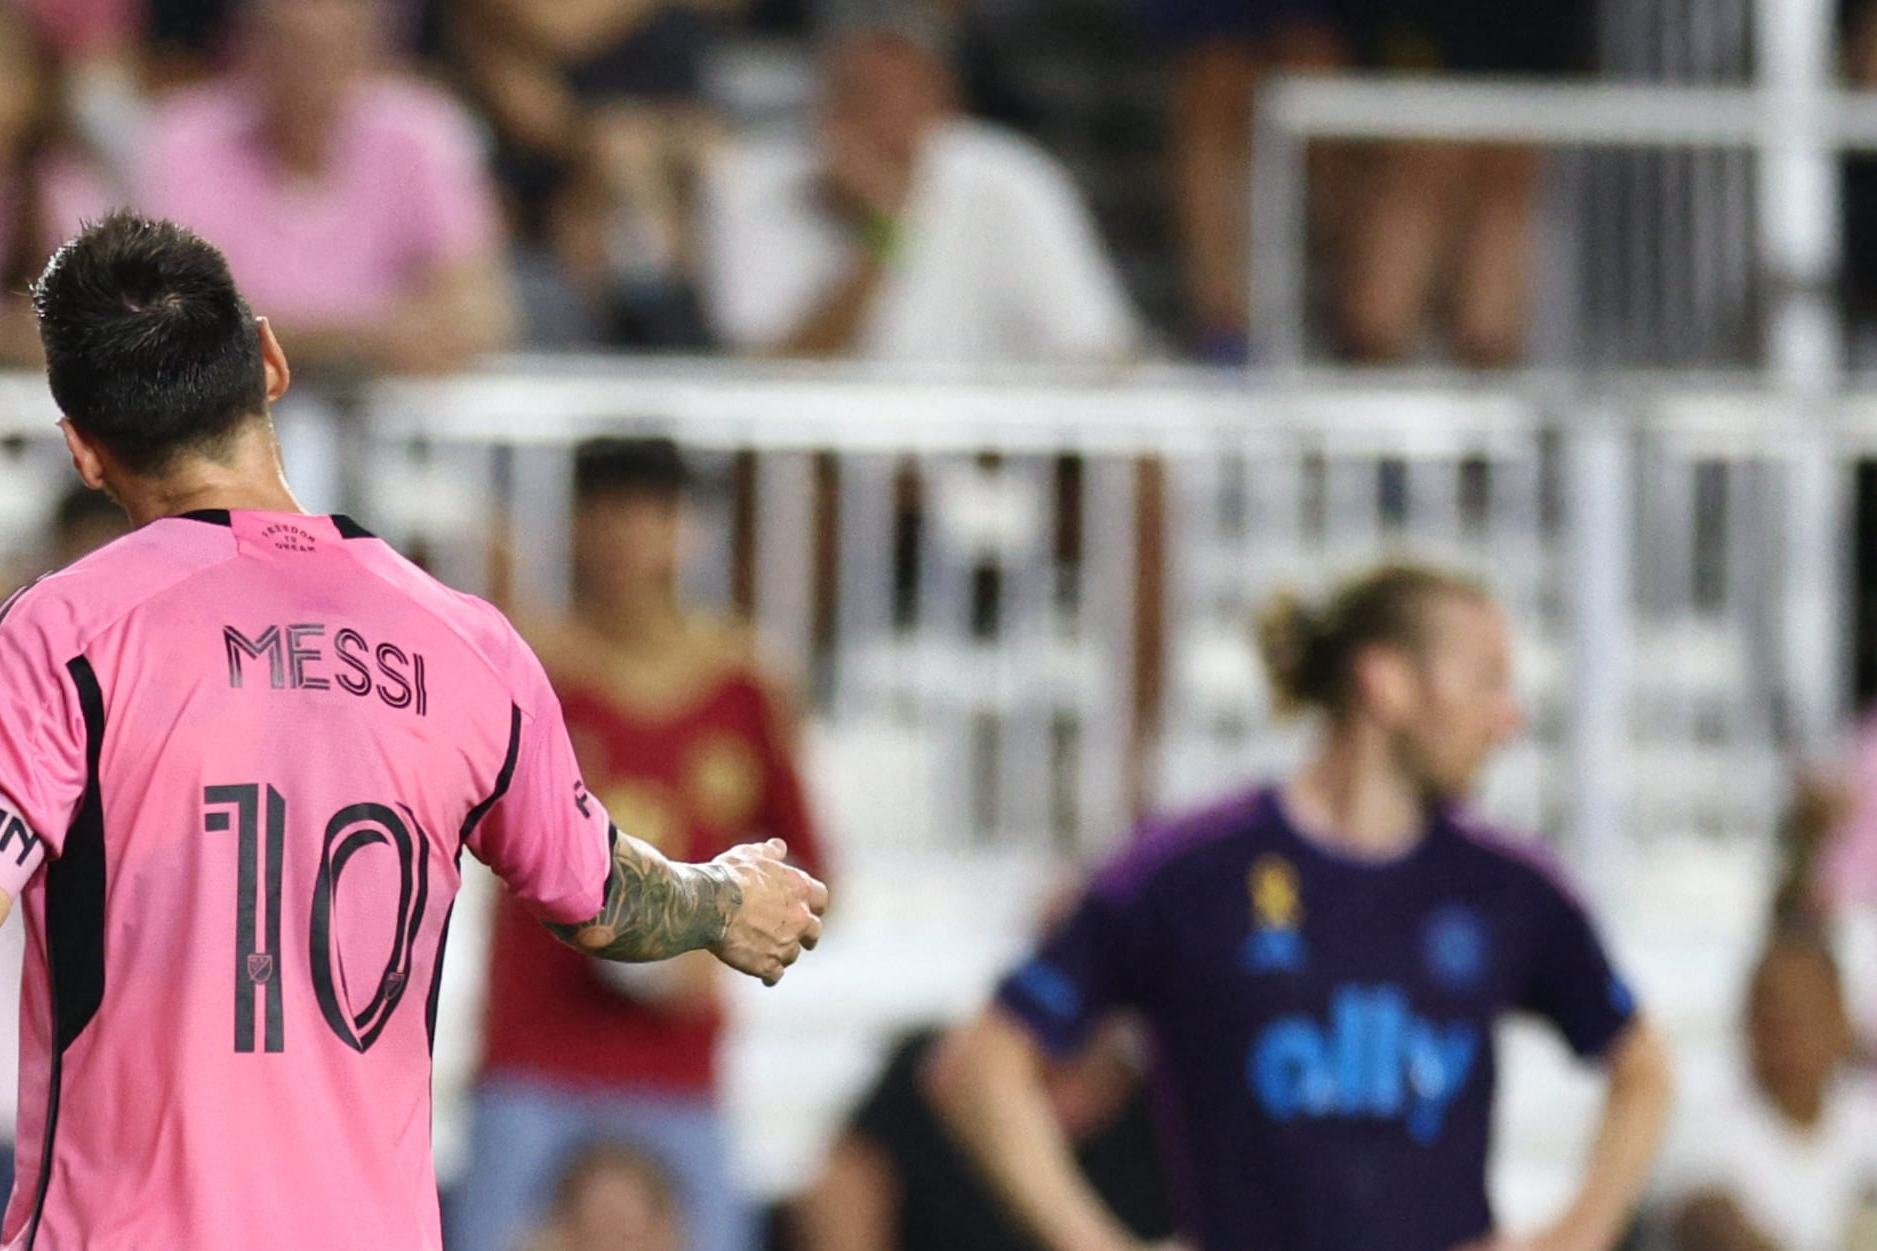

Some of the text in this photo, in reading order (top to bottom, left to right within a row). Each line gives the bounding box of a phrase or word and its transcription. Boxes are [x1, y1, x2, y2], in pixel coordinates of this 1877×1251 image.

[223, 623, 426, 717] MESSI
[204, 783, 430, 1054] 10
[1248, 984, 1480, 1142] ally
